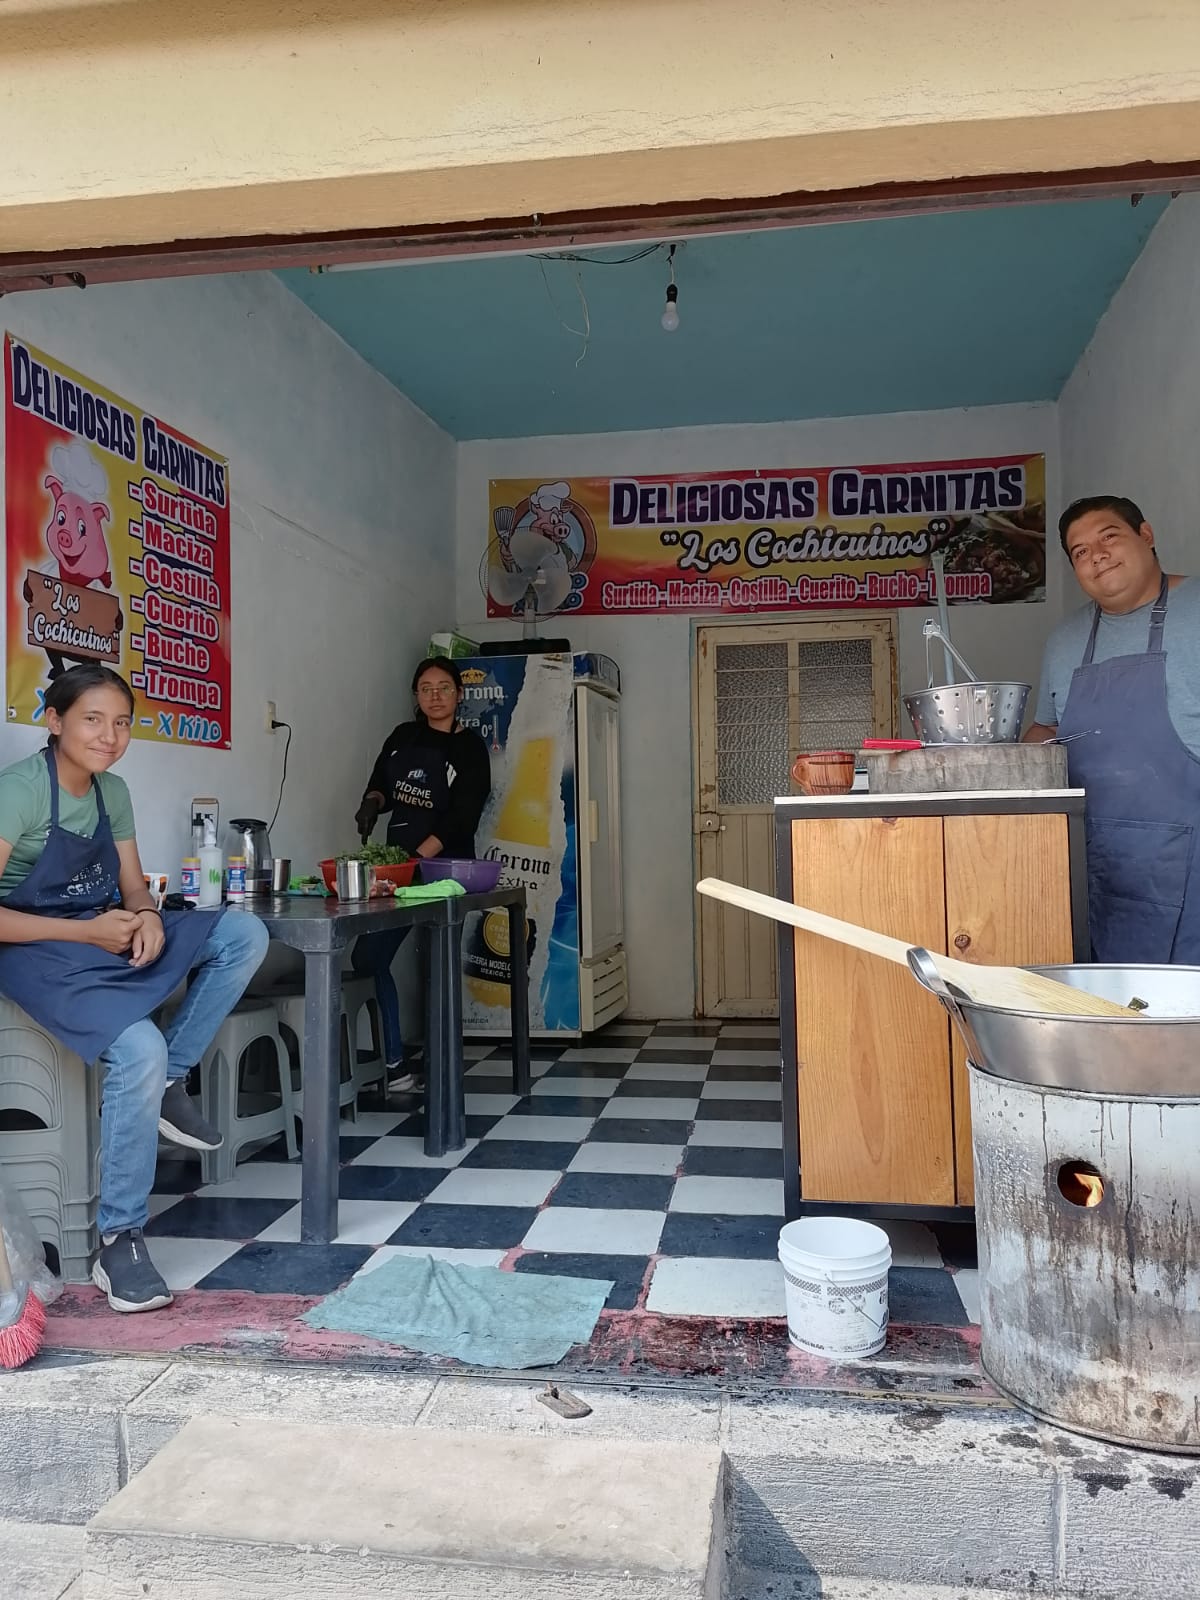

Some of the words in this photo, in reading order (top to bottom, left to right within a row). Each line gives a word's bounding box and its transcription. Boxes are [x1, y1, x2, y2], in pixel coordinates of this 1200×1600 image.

[12, 344, 137, 462] DELICIOSAS
[141, 415, 225, 506] CARNITAS
[612, 480, 815, 526] DELICIOSAS
[830, 466, 1023, 517] CARNITAS
[929, 571, 990, 600] Tompa
[462, 685, 505, 701] rona
[456, 716, 481, 728] tra
[397, 791, 434, 810] NUEVO
